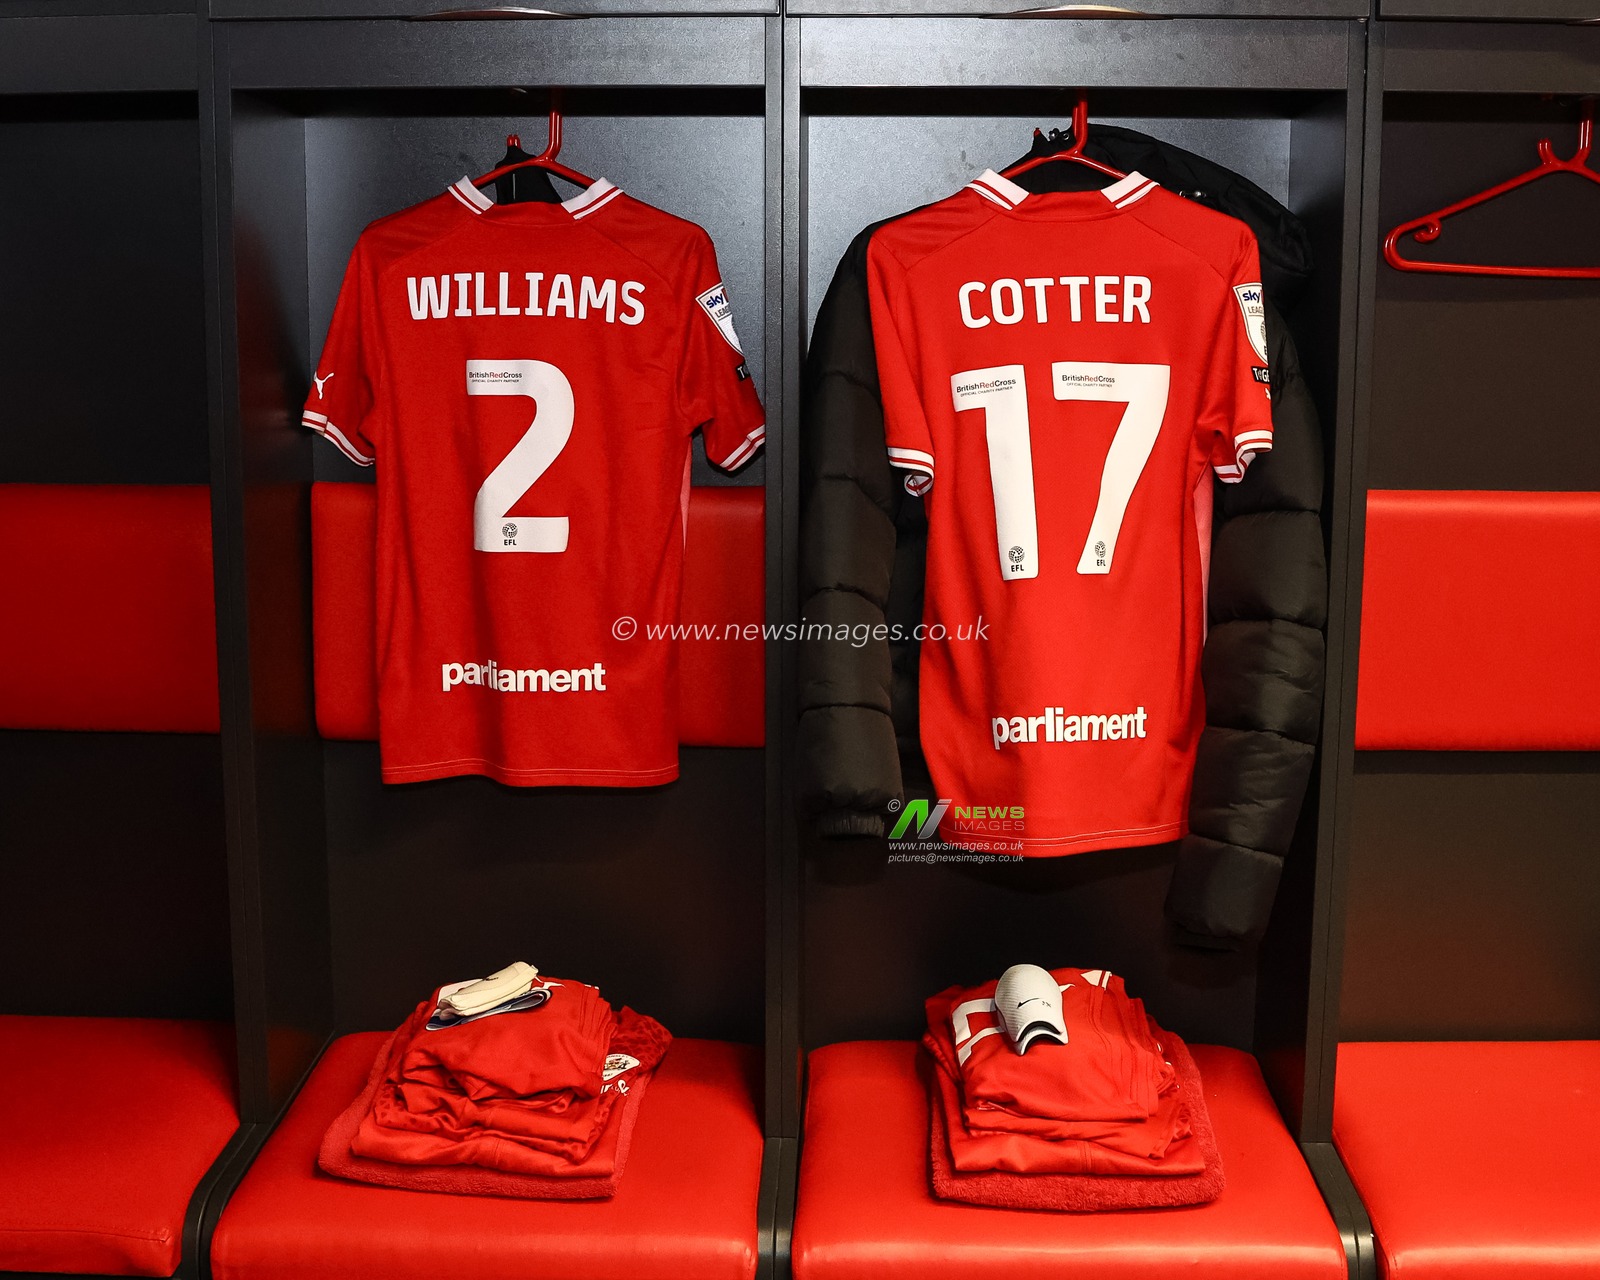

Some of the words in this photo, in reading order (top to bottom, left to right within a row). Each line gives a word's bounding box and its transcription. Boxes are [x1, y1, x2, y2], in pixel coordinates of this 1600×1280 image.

[406, 271, 646, 326] WILLIAMS
[706, 293, 724, 309] sky
[958, 275, 1152, 329] COTTER
[1242, 290, 1260, 303] sky
[466, 359, 575, 554] 2
[950, 361, 1171, 581] 17
[1010, 563, 1025, 573] EFL
[1096, 558, 1106, 568] EFL
[442, 659, 607, 692] parliament
[992, 706, 1148, 750] parliament
